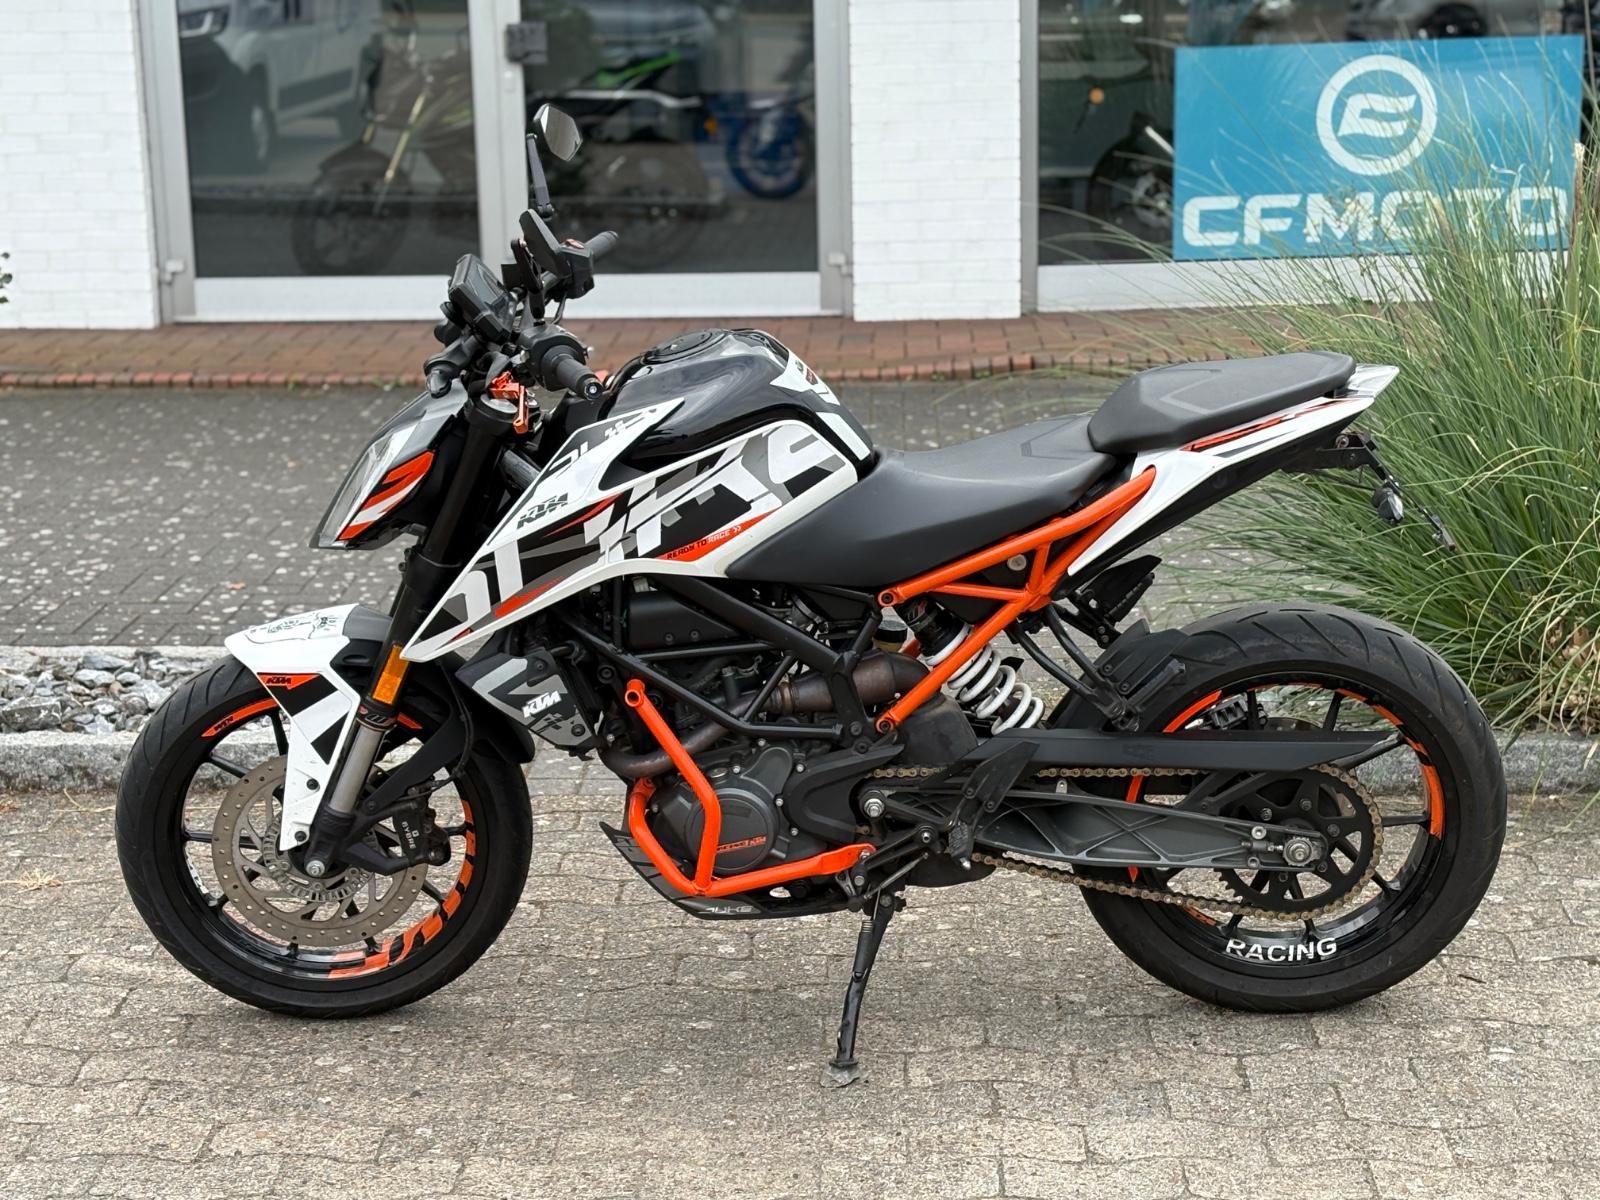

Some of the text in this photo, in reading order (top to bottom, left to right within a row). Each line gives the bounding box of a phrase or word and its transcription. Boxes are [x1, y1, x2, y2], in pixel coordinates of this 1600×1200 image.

[1182, 186, 1569, 247] CFMOTO
[516, 492, 569, 529] KTM
[666, 528, 732, 561] READY TO RACE
[265, 676, 292, 686] KTM
[521, 690, 563, 719] KTM
[1225, 937, 1337, 962] RACING
